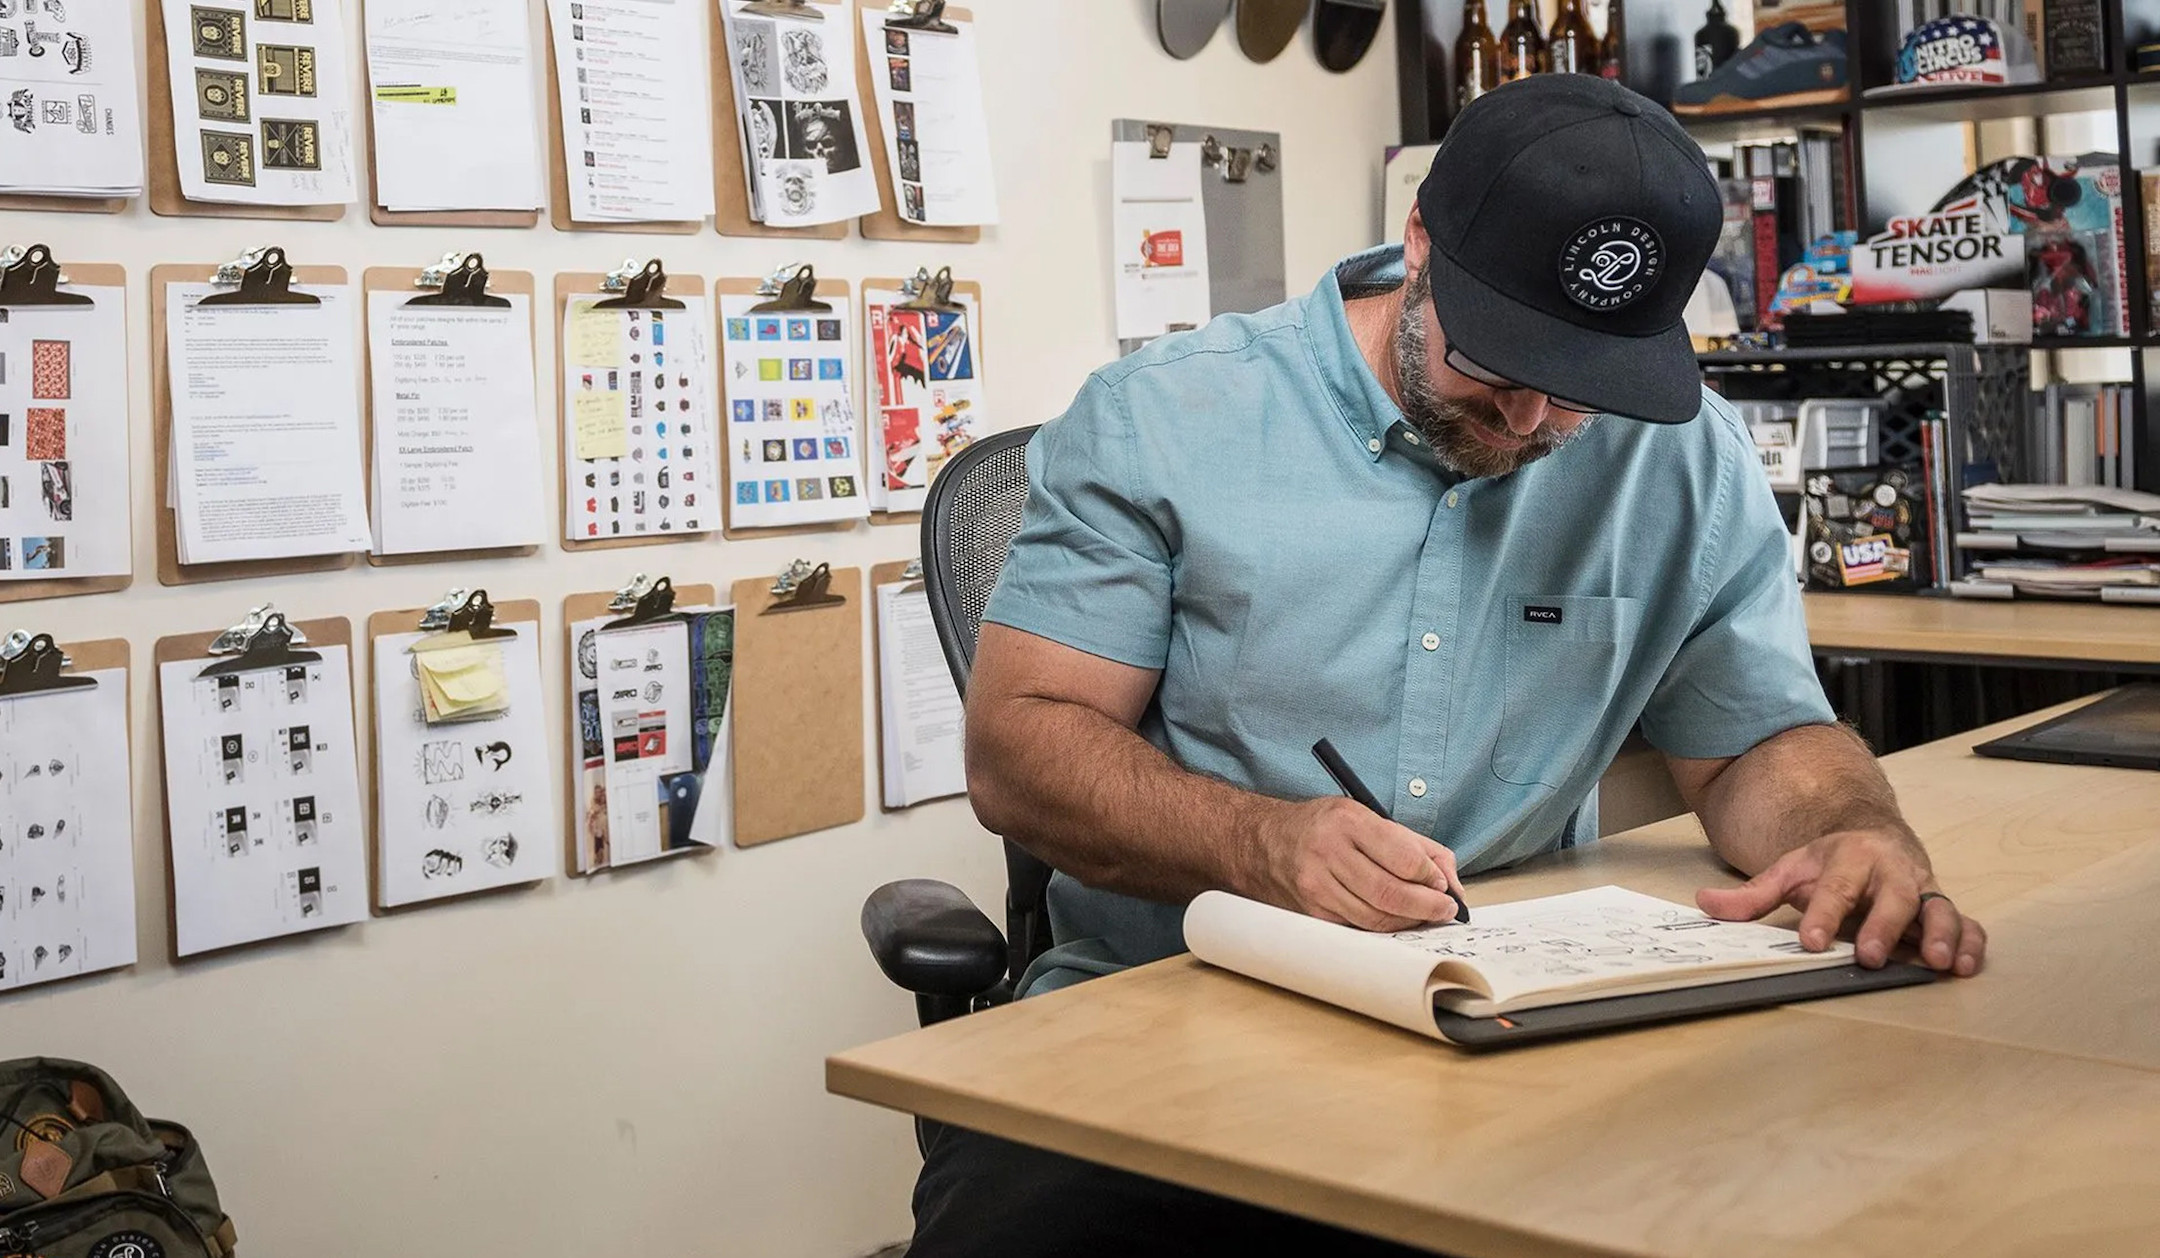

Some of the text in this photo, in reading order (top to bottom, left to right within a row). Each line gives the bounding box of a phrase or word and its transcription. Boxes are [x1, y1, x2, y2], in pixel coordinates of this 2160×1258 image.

[231, 16, 242, 54] REVERE
[1916, 34, 1975, 58] NITRO
[301, 52, 313, 92] REVERE
[1917, 47, 1984, 74] CIRCUS
[234, 79, 245, 117] REVERE
[239, 141, 250, 179] REVERE
[303, 127, 315, 164] REVERE
[1890, 213, 1981, 240] SKATE
[1564, 223, 1658, 307] LINCOLN DESIGN COMPANY
[1870, 235, 2004, 270] TENSOR
[1843, 539, 1887, 567] USA
[1529, 610, 1556, 619] RVCA
[612, 688, 638, 700] AIRO
